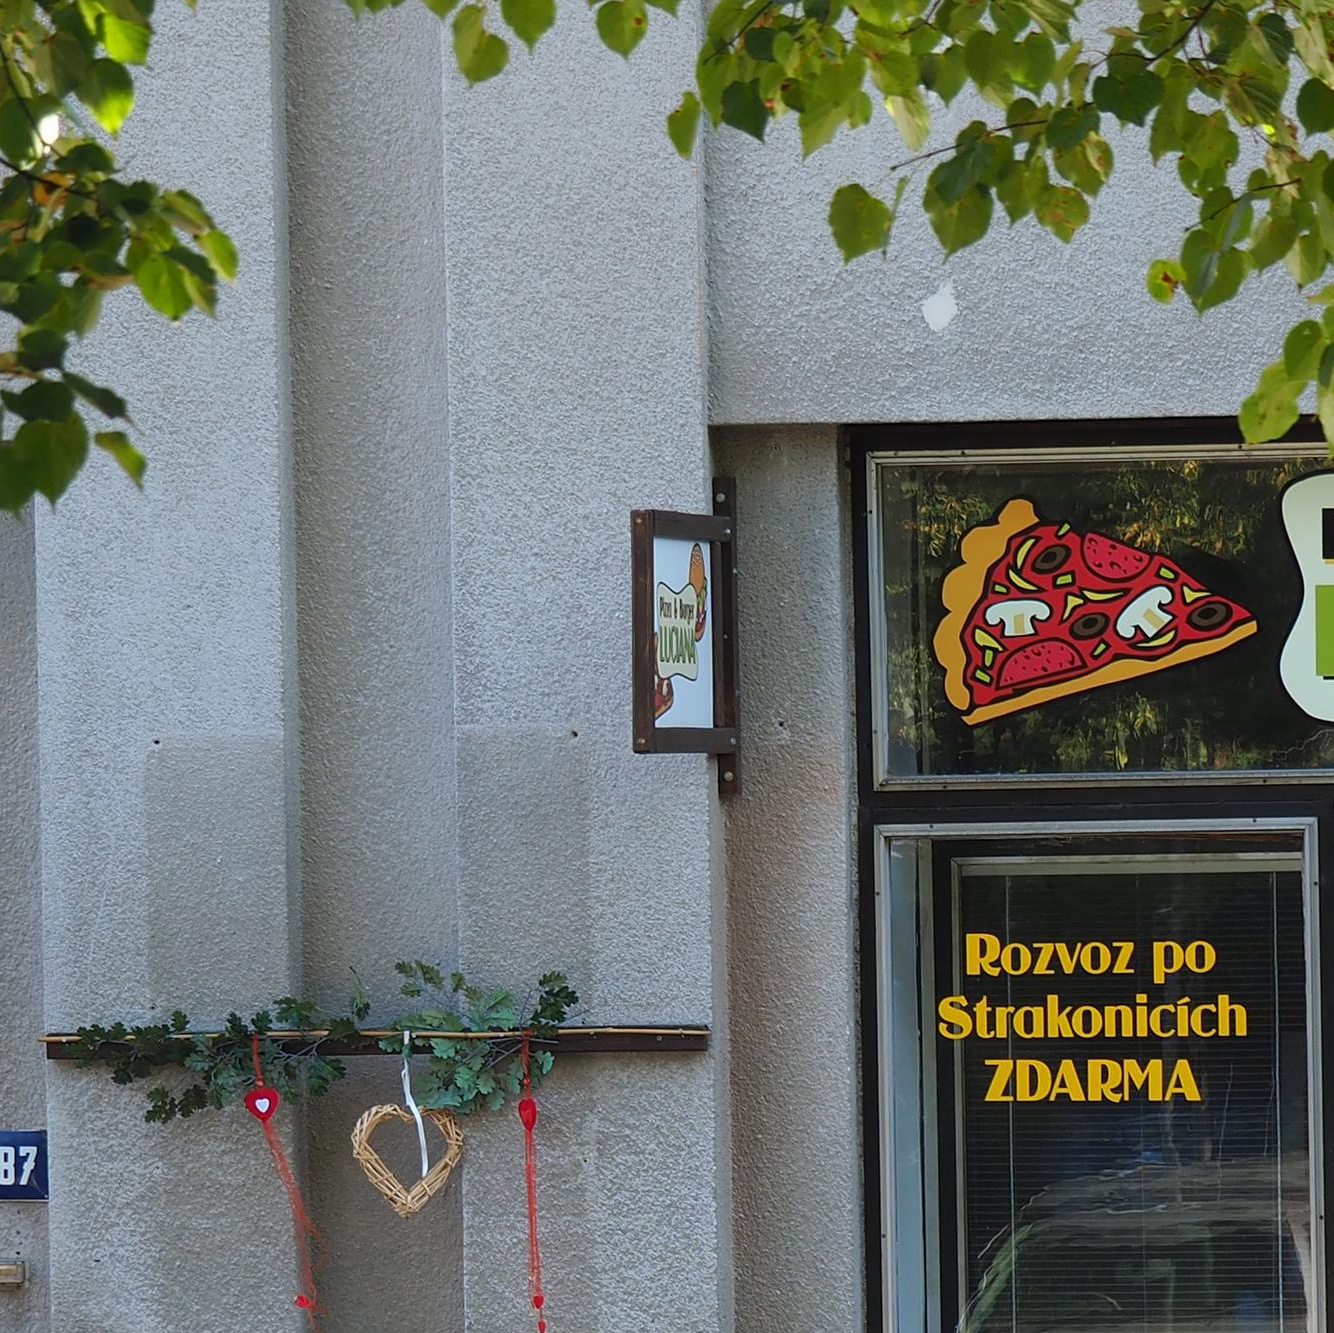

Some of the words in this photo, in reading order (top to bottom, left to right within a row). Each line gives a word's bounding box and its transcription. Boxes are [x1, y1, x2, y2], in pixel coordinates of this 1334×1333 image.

[659, 596, 672, 617] Pizza
[679, 597, 695, 625] Burger
[659, 624, 696, 665] LUCIANA
[965, 933, 1135, 977] Rozvoz
[1152, 940, 1217, 984] po
[937, 994, 1248, 1040] Strakonicích
[984, 1059, 1202, 1103] ZDARMA
